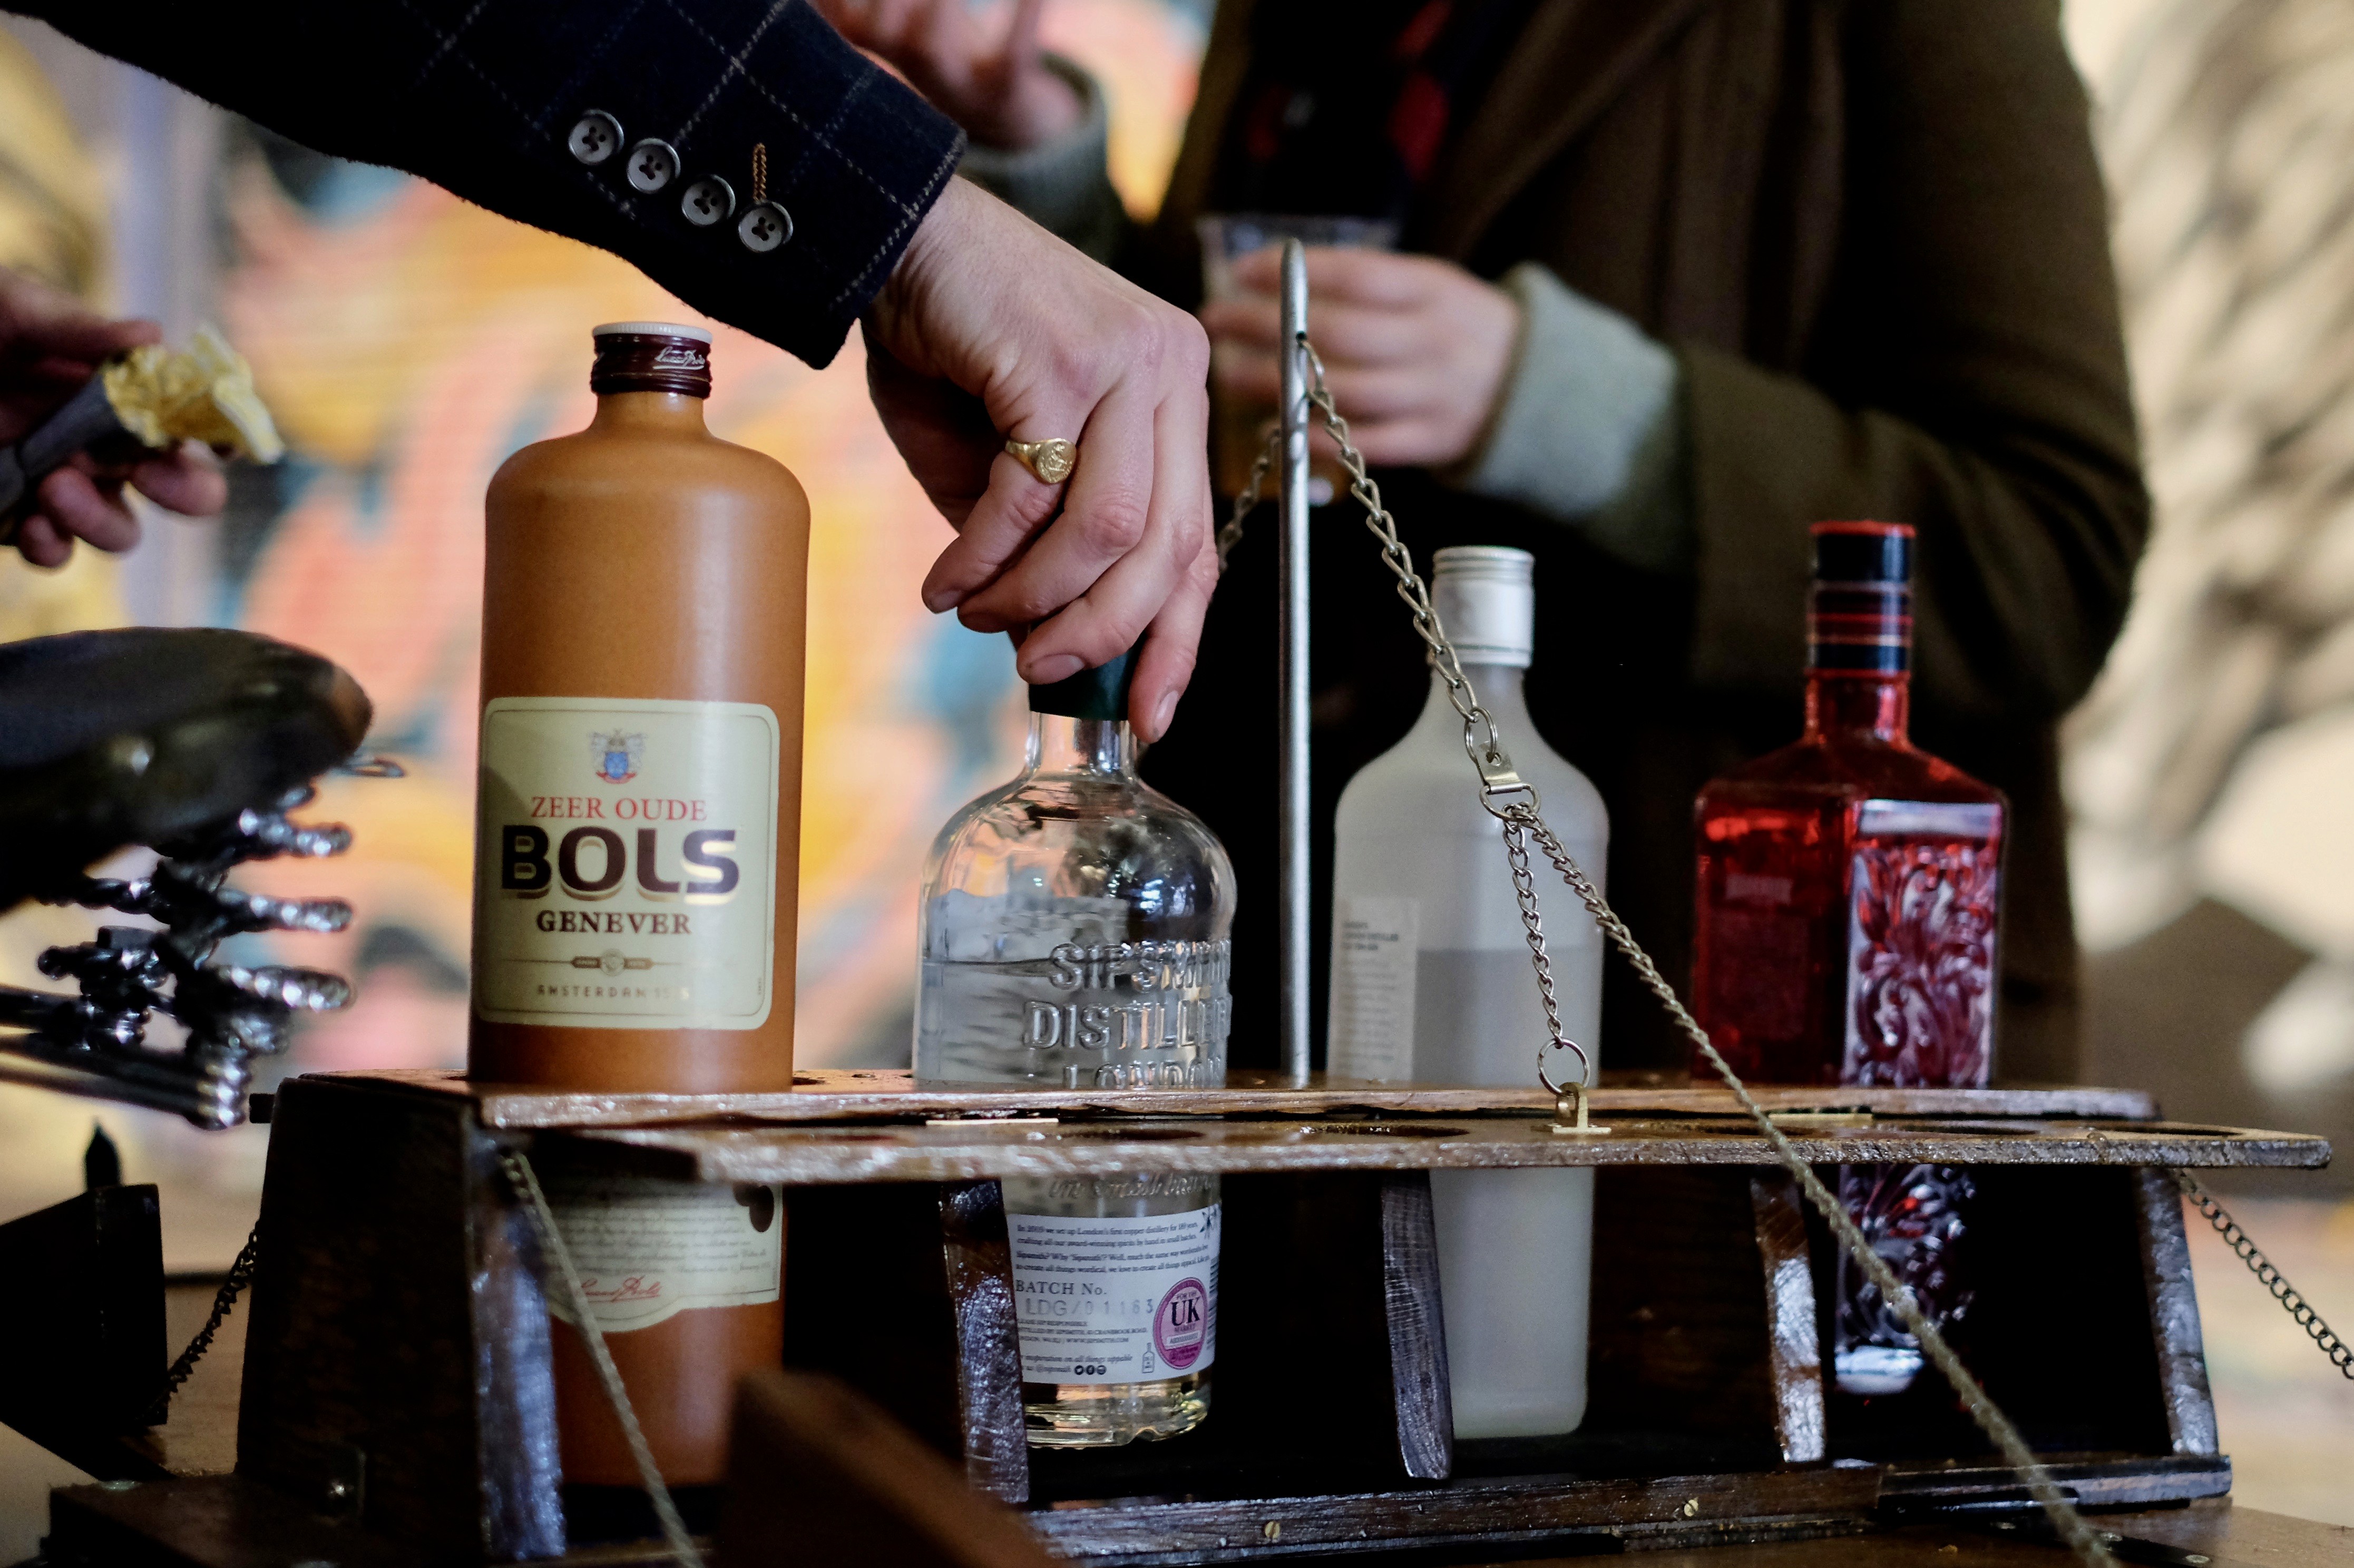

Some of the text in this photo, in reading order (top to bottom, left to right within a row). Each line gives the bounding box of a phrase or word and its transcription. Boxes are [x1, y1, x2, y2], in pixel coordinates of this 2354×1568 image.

[531, 796, 707, 822] ZEER OUDE
[502, 824, 740, 899] BOLS
[536, 910, 692, 935] GENEVER
[538, 984, 647, 998] AMSTERDAM
[1015, 1279, 1107, 1295] BATCH No.
[1170, 1296, 1200, 1326] UK
